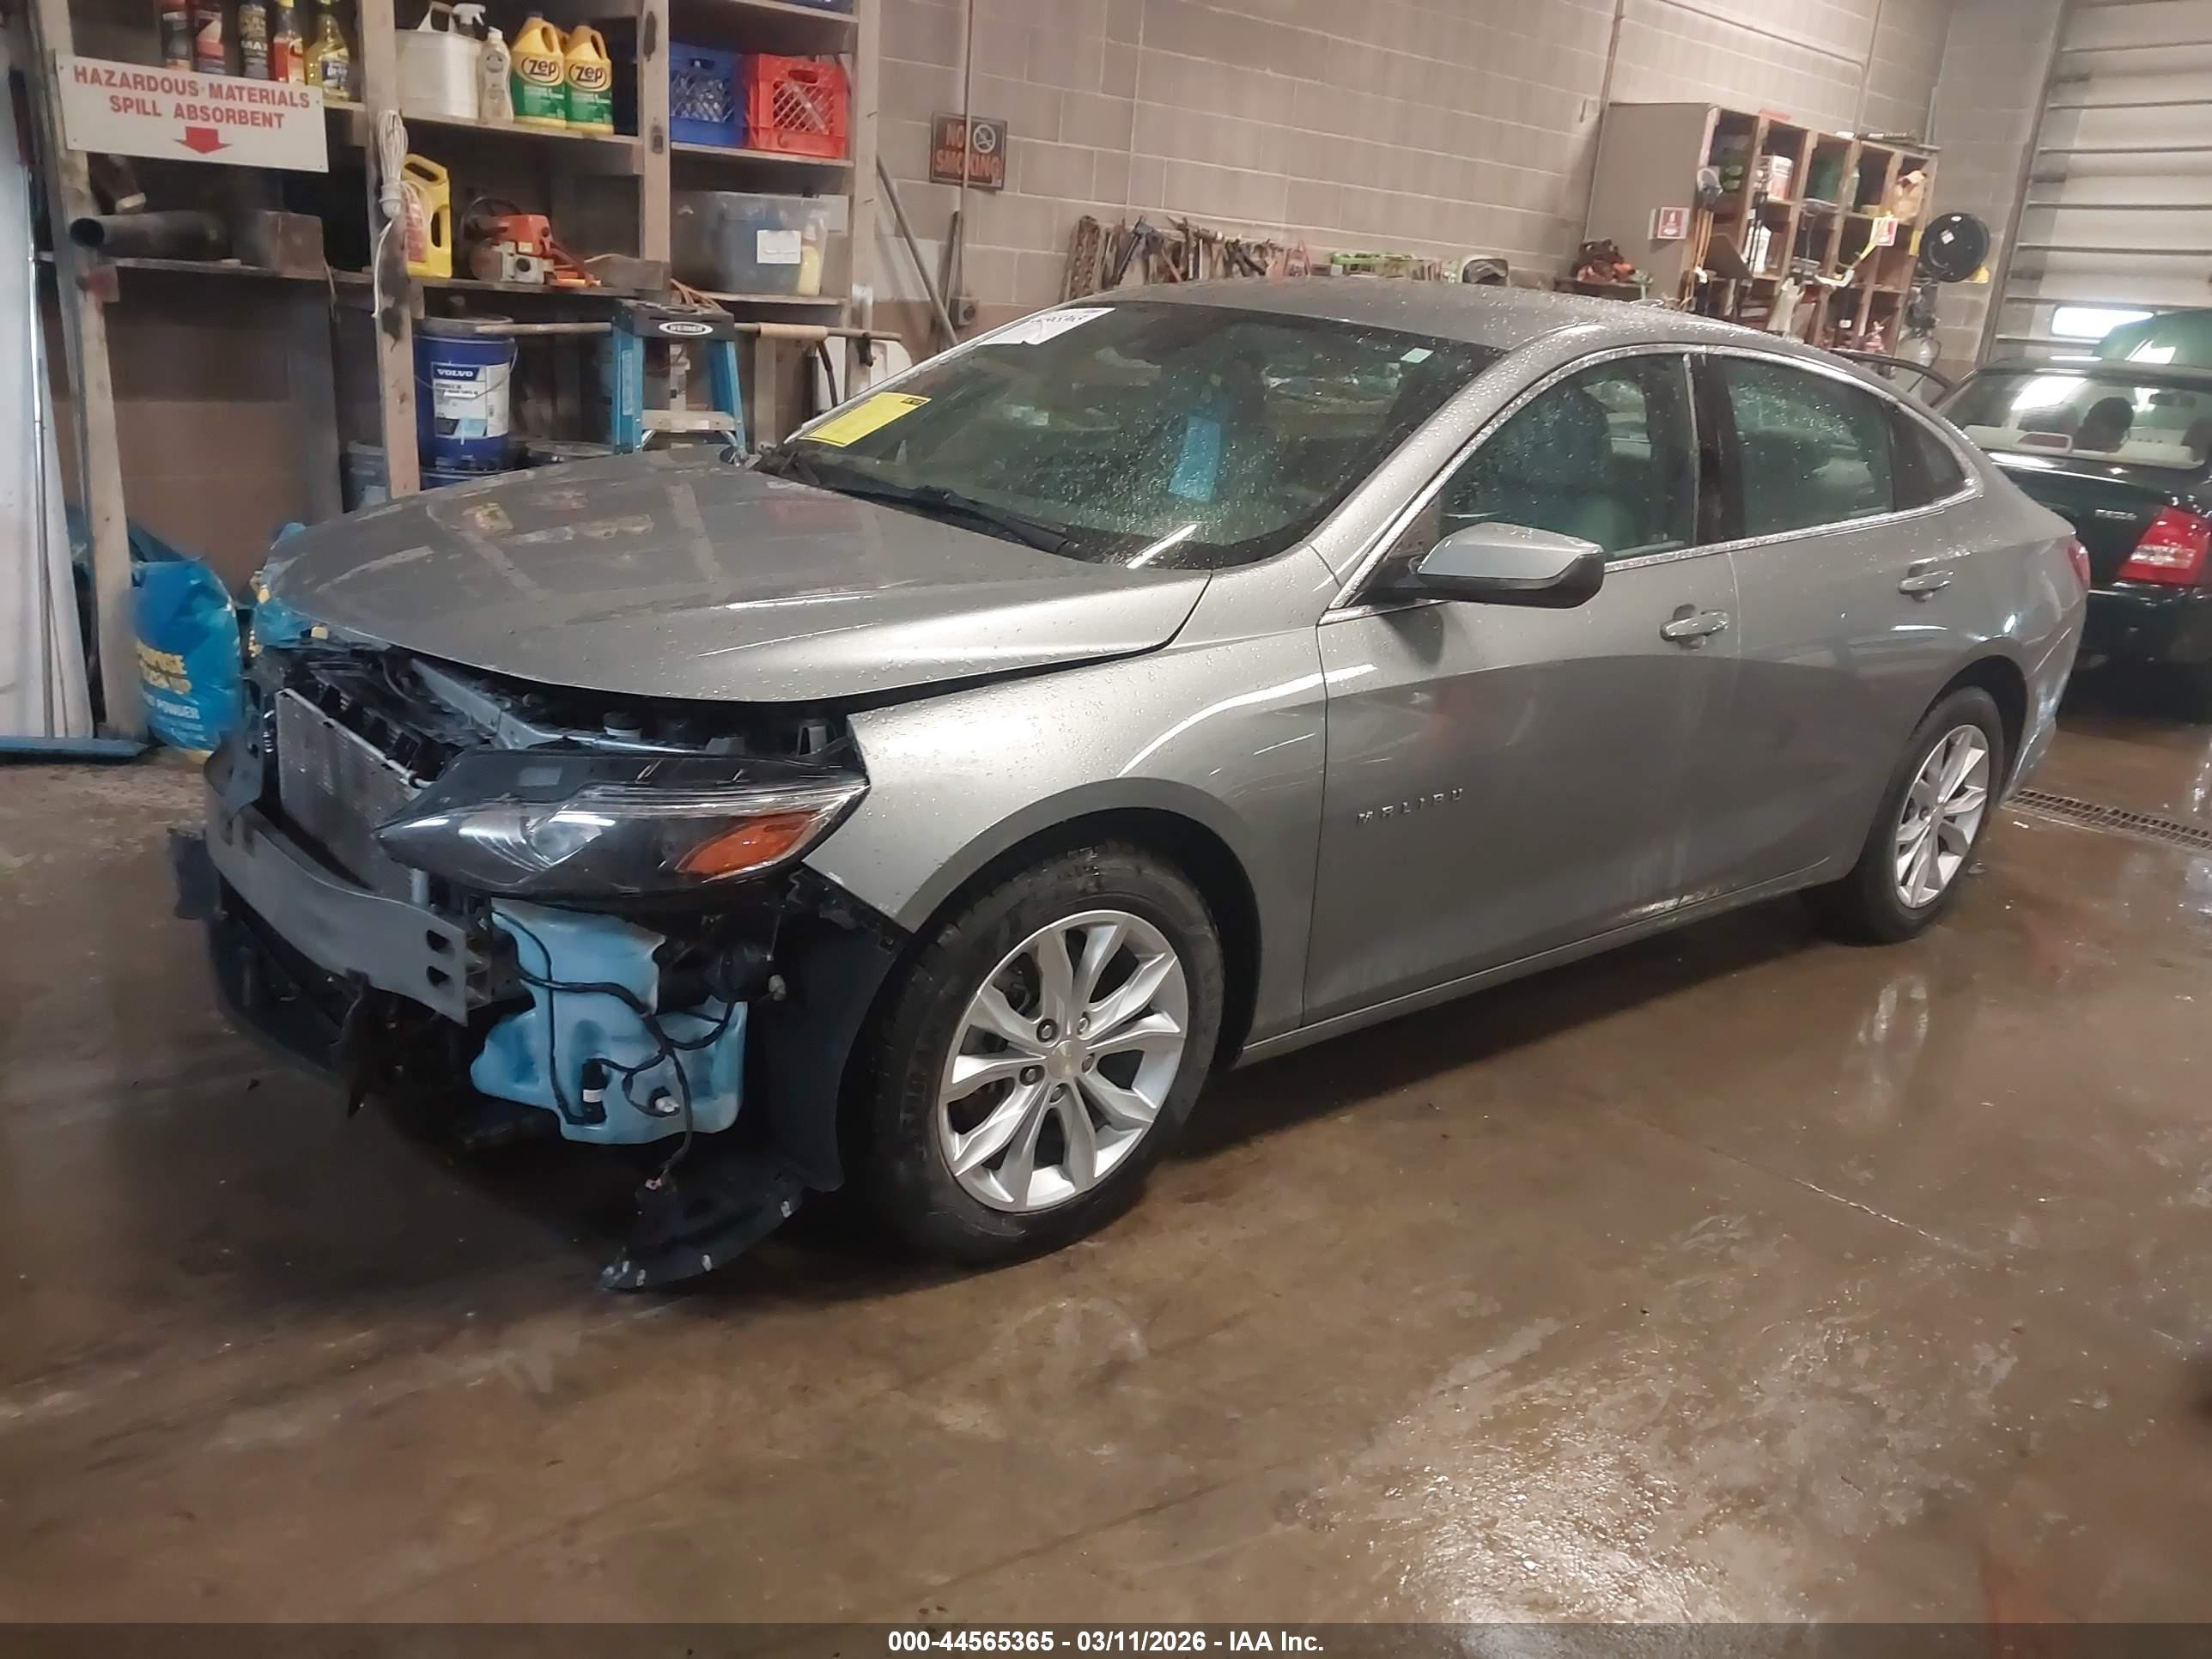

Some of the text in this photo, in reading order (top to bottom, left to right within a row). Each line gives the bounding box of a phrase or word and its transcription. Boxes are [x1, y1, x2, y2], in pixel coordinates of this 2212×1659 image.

[74, 64, 310, 109] HAZARDOUS MATERIALS
[109, 94, 285, 129] SPILL ABSORBENT
[437, 368, 474, 377] VOLVO
[1356, 787, 1463, 825] MALIBU
